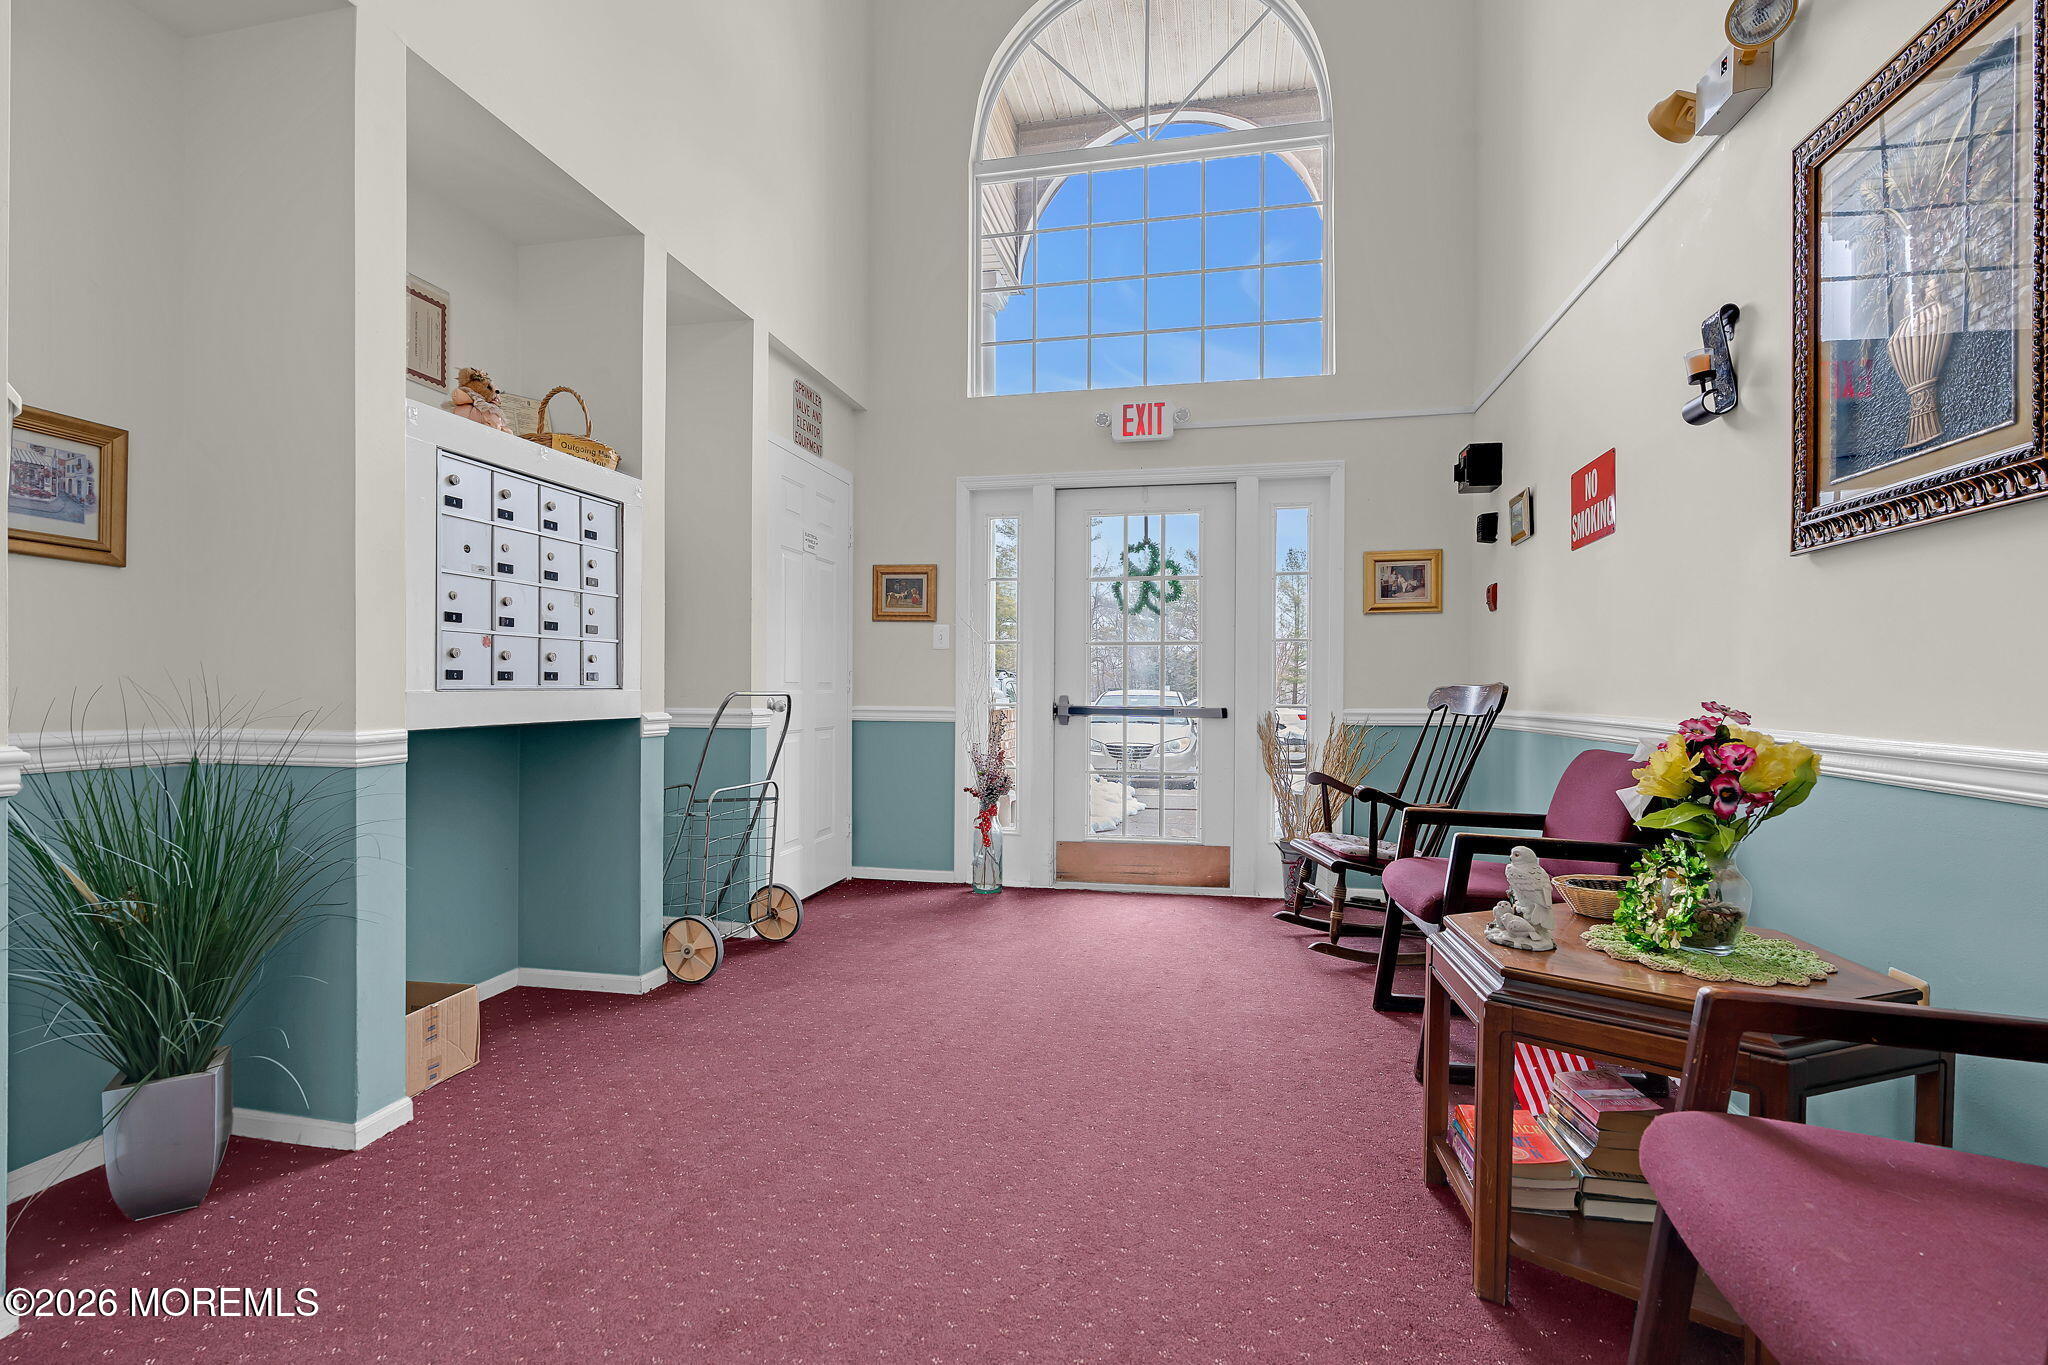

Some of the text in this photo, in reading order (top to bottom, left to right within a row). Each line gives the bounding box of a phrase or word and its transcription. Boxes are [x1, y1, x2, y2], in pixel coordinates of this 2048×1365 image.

[795, 397, 822, 425] VALVE AND
[1123, 402, 1165, 436] EXIT
[796, 414, 821, 440] ELEVATOR
[560, 441, 597, 457] Outgoing
[795, 430, 823, 457] EQUIPMENT
[1585, 468, 1598, 502] NO
[1572, 495, 1614, 543] SMOKING
